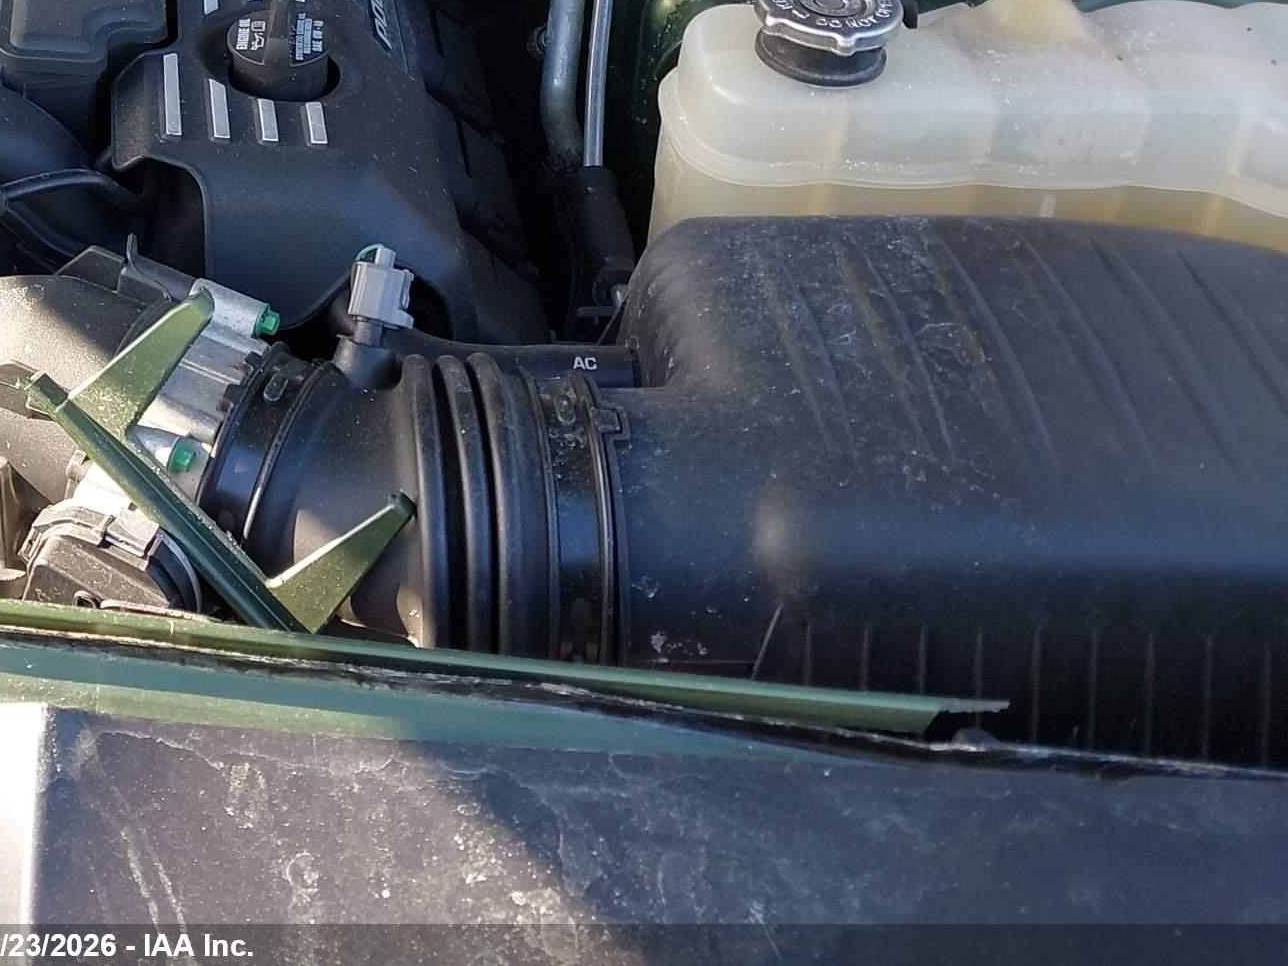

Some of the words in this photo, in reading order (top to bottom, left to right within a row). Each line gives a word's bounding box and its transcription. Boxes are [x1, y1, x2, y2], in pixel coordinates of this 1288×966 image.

[238, 17, 251, 27] OIL
[816, 17, 843, 29] DO
[845, 16, 879, 29] NOT
[236, 27, 250, 50] ENGINE
[573, 356, 597, 370] AC
